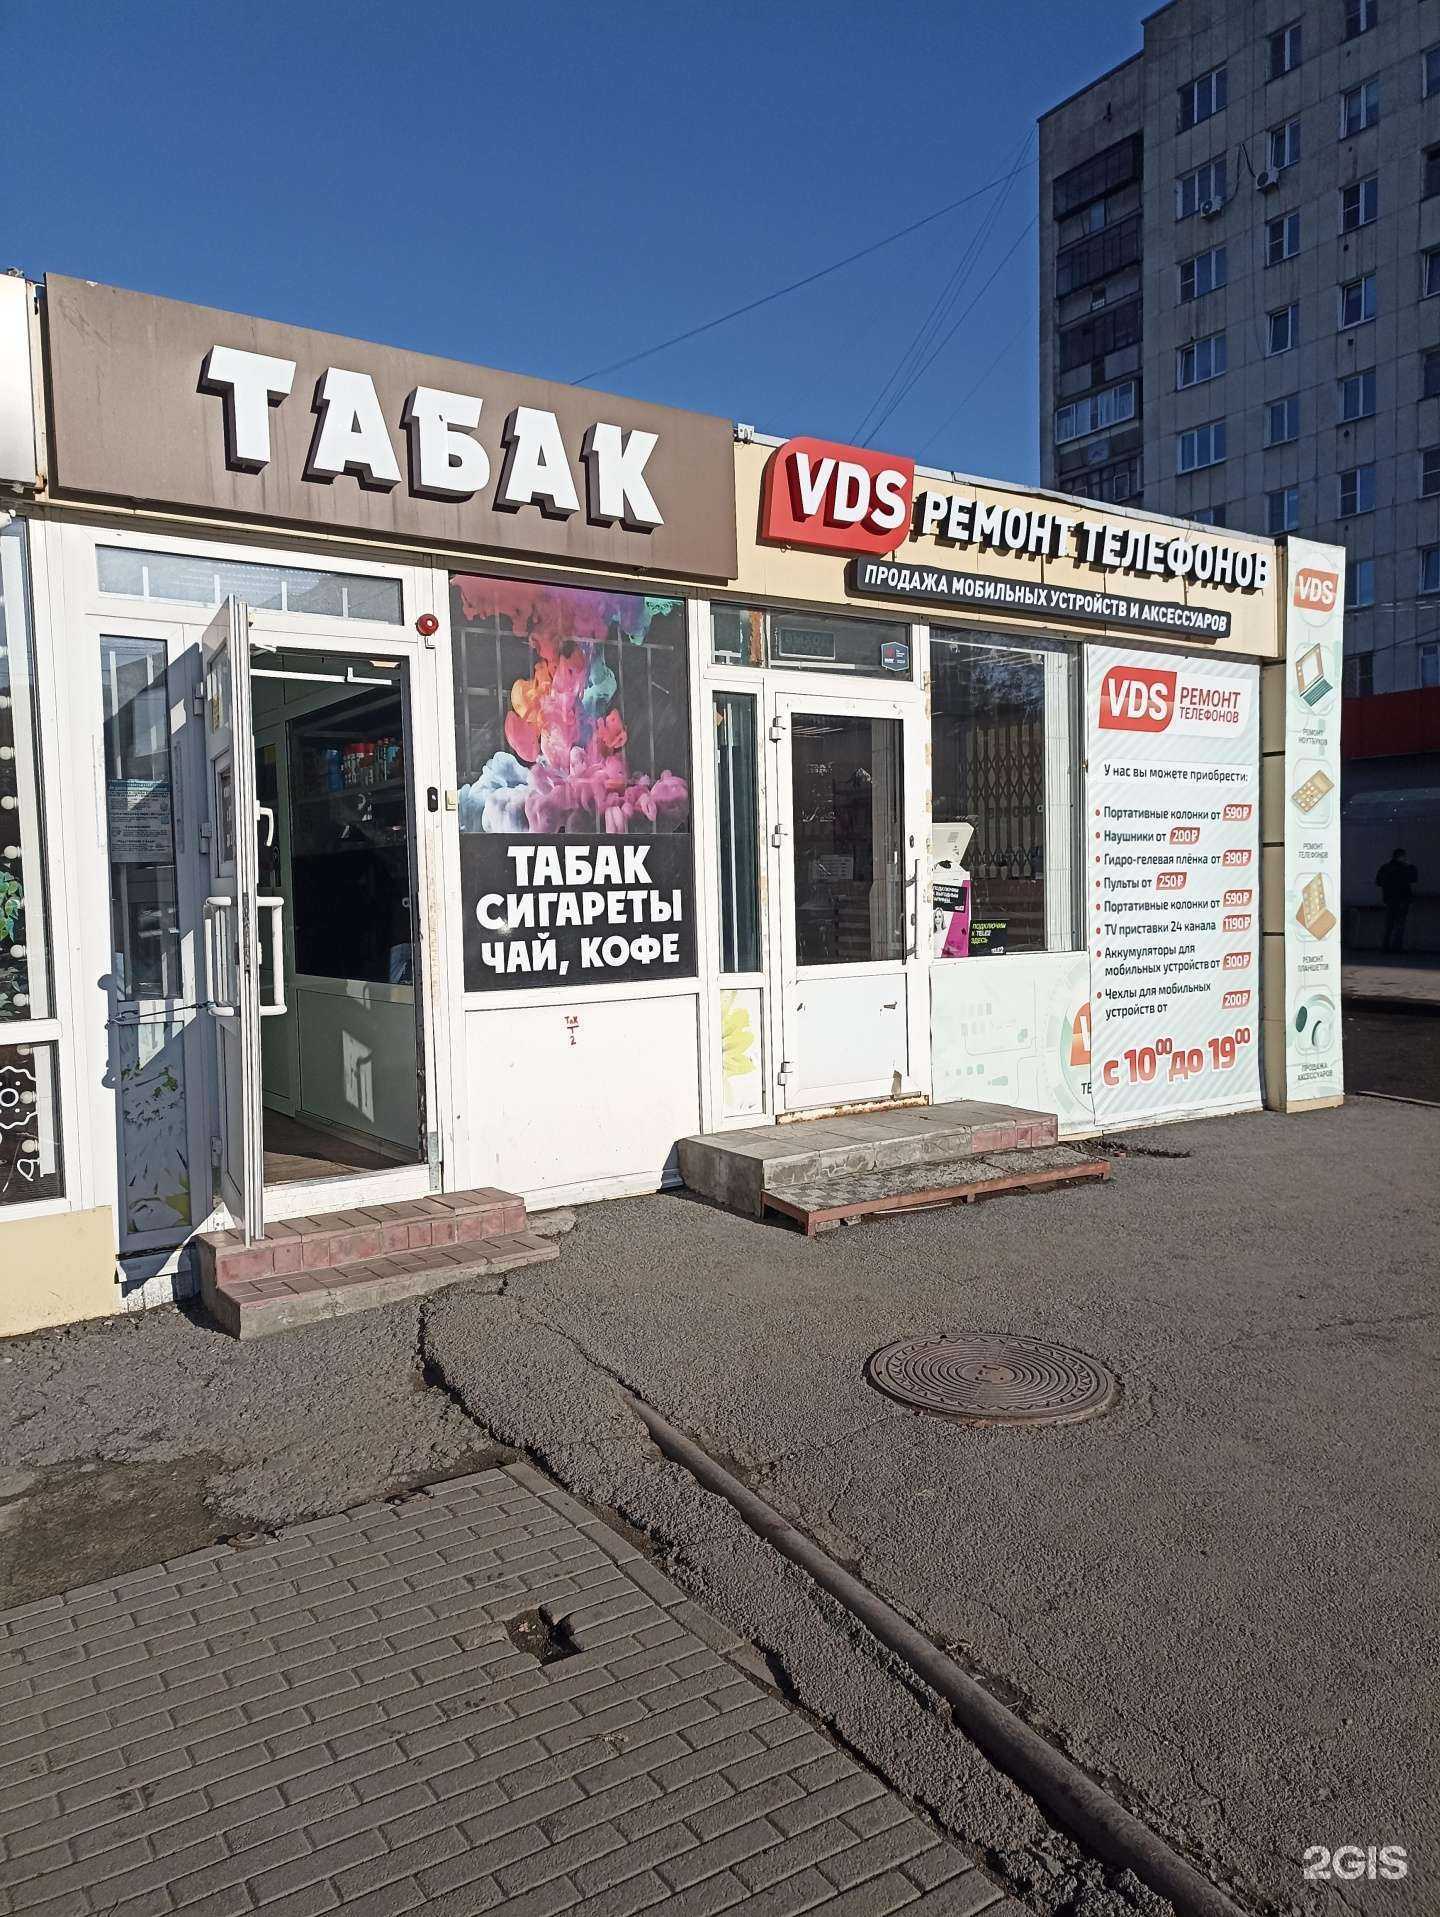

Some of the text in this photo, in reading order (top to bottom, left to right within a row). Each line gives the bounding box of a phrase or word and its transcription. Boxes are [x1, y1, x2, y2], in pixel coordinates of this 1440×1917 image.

[202, 343, 665, 528] ТАБАК
[792, 451, 908, 531] VDS
[921, 490, 1273, 590] РЕМОНТ ТЕЛЕФОНОВ
[864, 564, 1227, 632] ПРОДАЖА МОБИЛЬНЫХ УСТРОЙСТВ И АКСЕССУАРОВ
[1298, 575, 1334, 605] VDS
[1108, 678, 1168, 721] VDS
[1179, 686, 1241, 709] РЕМОНТ
[1179, 706, 1239, 723] ТЕЛЕФОНОВ
[1104, 763, 1248, 782] У нас вы можете приобрести:
[1103, 806, 1169, 820] Портативные
[1170, 810, 1209, 820] колонки
[1210, 811, 1221, 820] от
[1103, 829, 1154, 845] Наушники
[1155, 832, 1167, 842] от
[507, 845, 653, 887] ТАБАК
[1103, 853, 1174, 868] Гидро-гелевая
[1175, 853, 1208, 865] плёнка
[1210, 855, 1221, 864] от
[1103, 877, 1139, 892] Пульты
[1141, 878, 1152, 888] от
[476, 889, 683, 930] СИГАРЕТЫ
[1104, 900, 1169, 914] Портативные
[1170, 900, 1209, 910] колонки
[1210, 899, 1220, 908] от
[1104, 923, 1118, 935] TV
[1118, 924, 1169, 938] приставки
[1170, 921, 1183, 933] 24
[1184, 921, 1217, 931] канала
[481, 931, 680, 976] ЧАЙ, КОФЕ
[1104, 944, 1196, 960] Аккумуляторы для
[1105, 963, 1161, 977] мобильных
[1163, 960, 1210, 974] устройств
[1210, 959, 1221, 968] от
[1105, 982, 1212, 1000] Чехлы для мобильных
[1105, 1004, 1155, 1021] устройств
[1157, 1003, 1168, 1013] от
[1168, 1048, 1204, 1082] до
